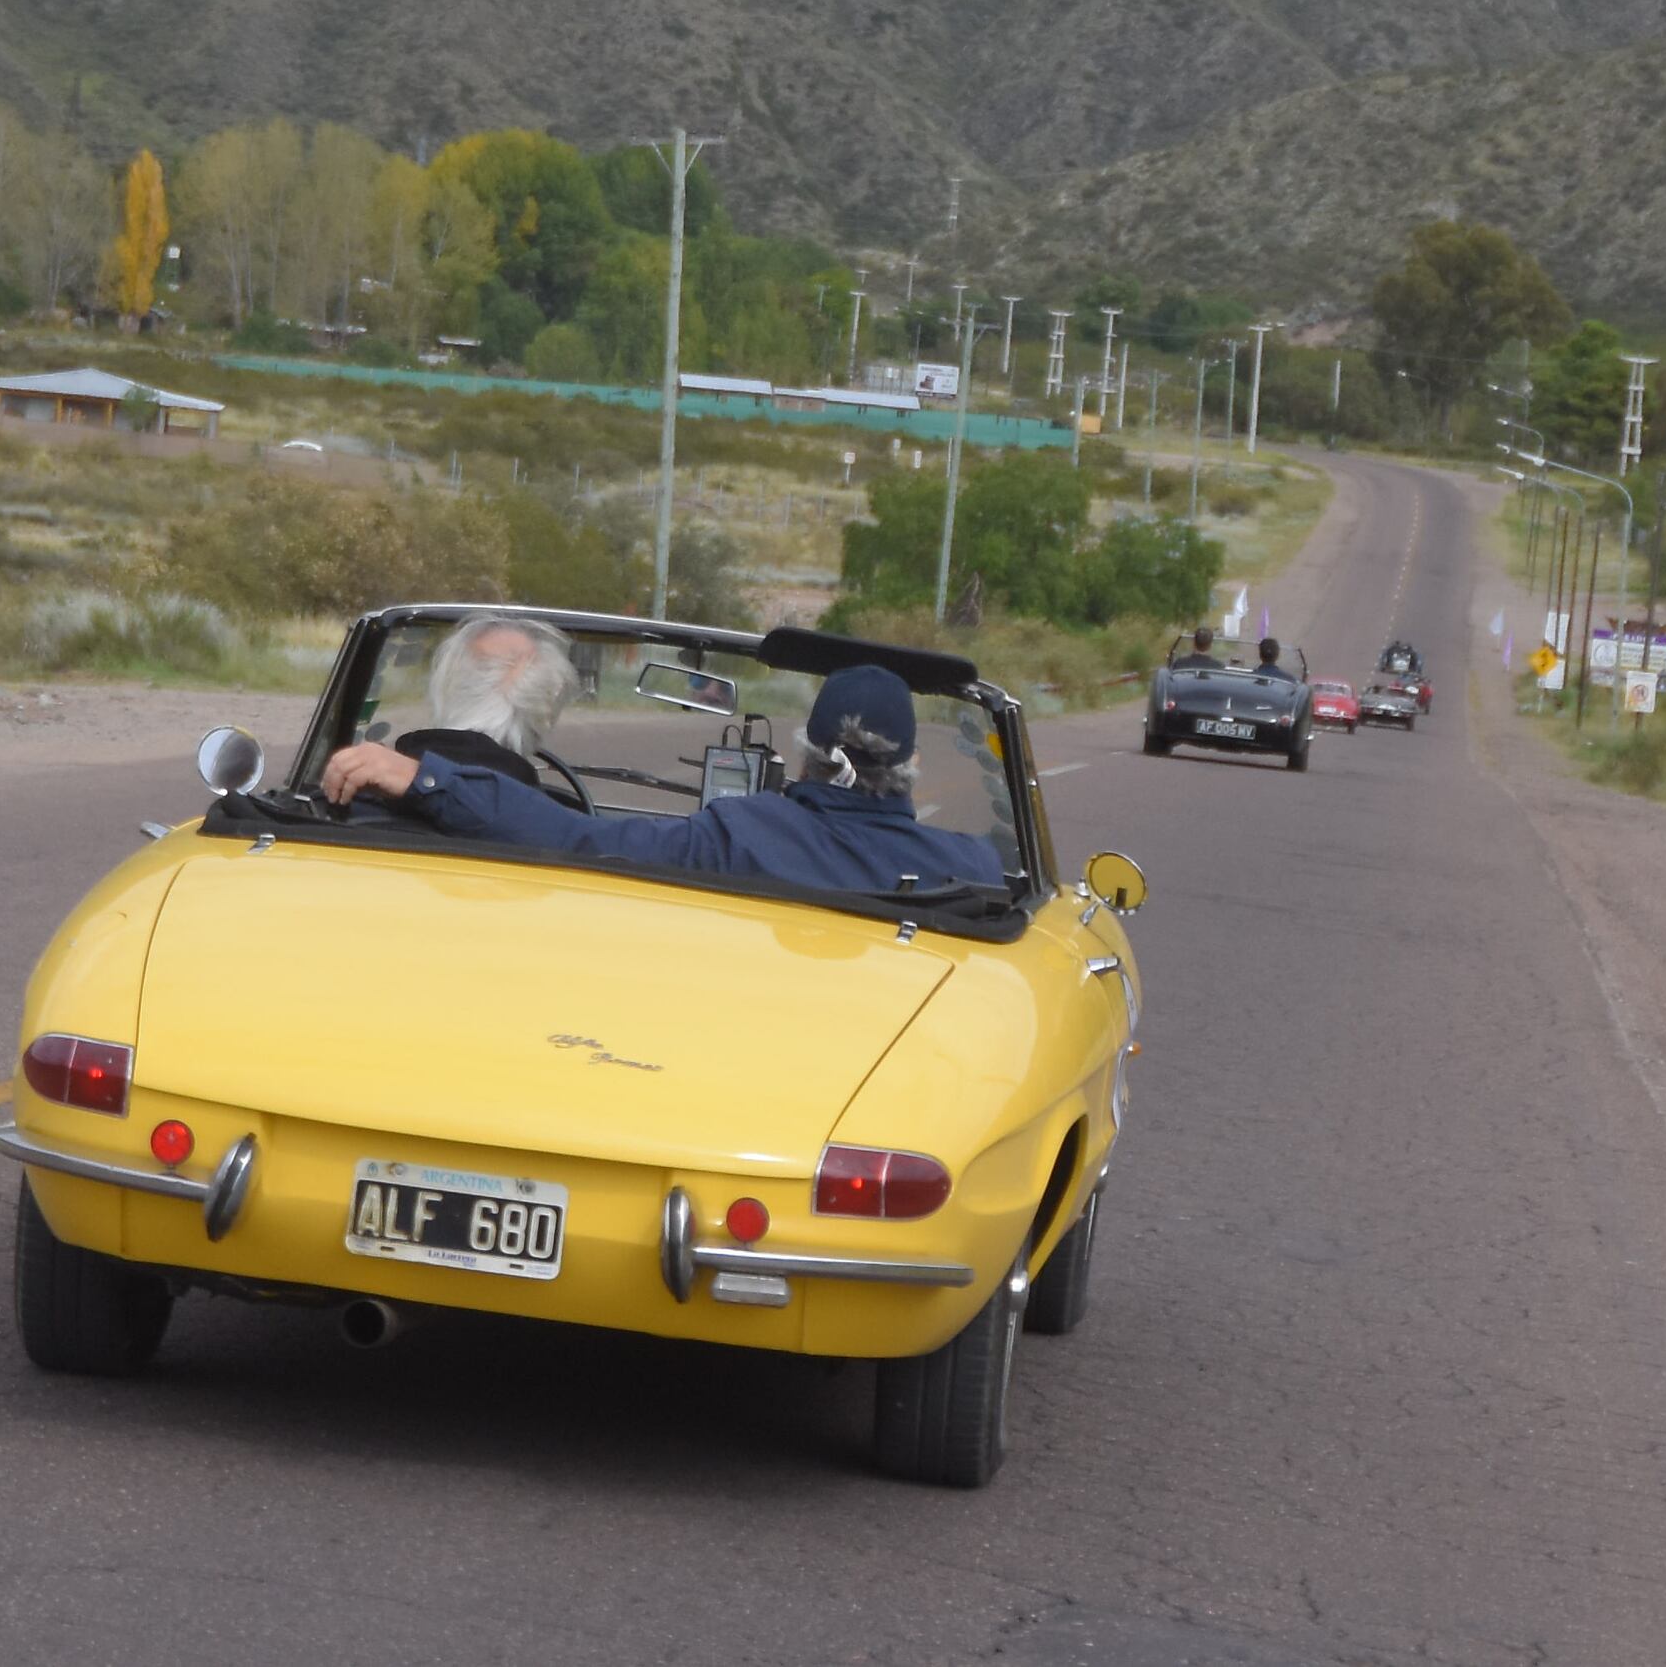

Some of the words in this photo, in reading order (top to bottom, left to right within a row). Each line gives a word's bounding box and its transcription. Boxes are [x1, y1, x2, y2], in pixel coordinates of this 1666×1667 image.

[421, 1169, 502, 1191] ARGENTINA
[356, 1184, 444, 1243] ALF
[470, 1199, 557, 1259] 680
